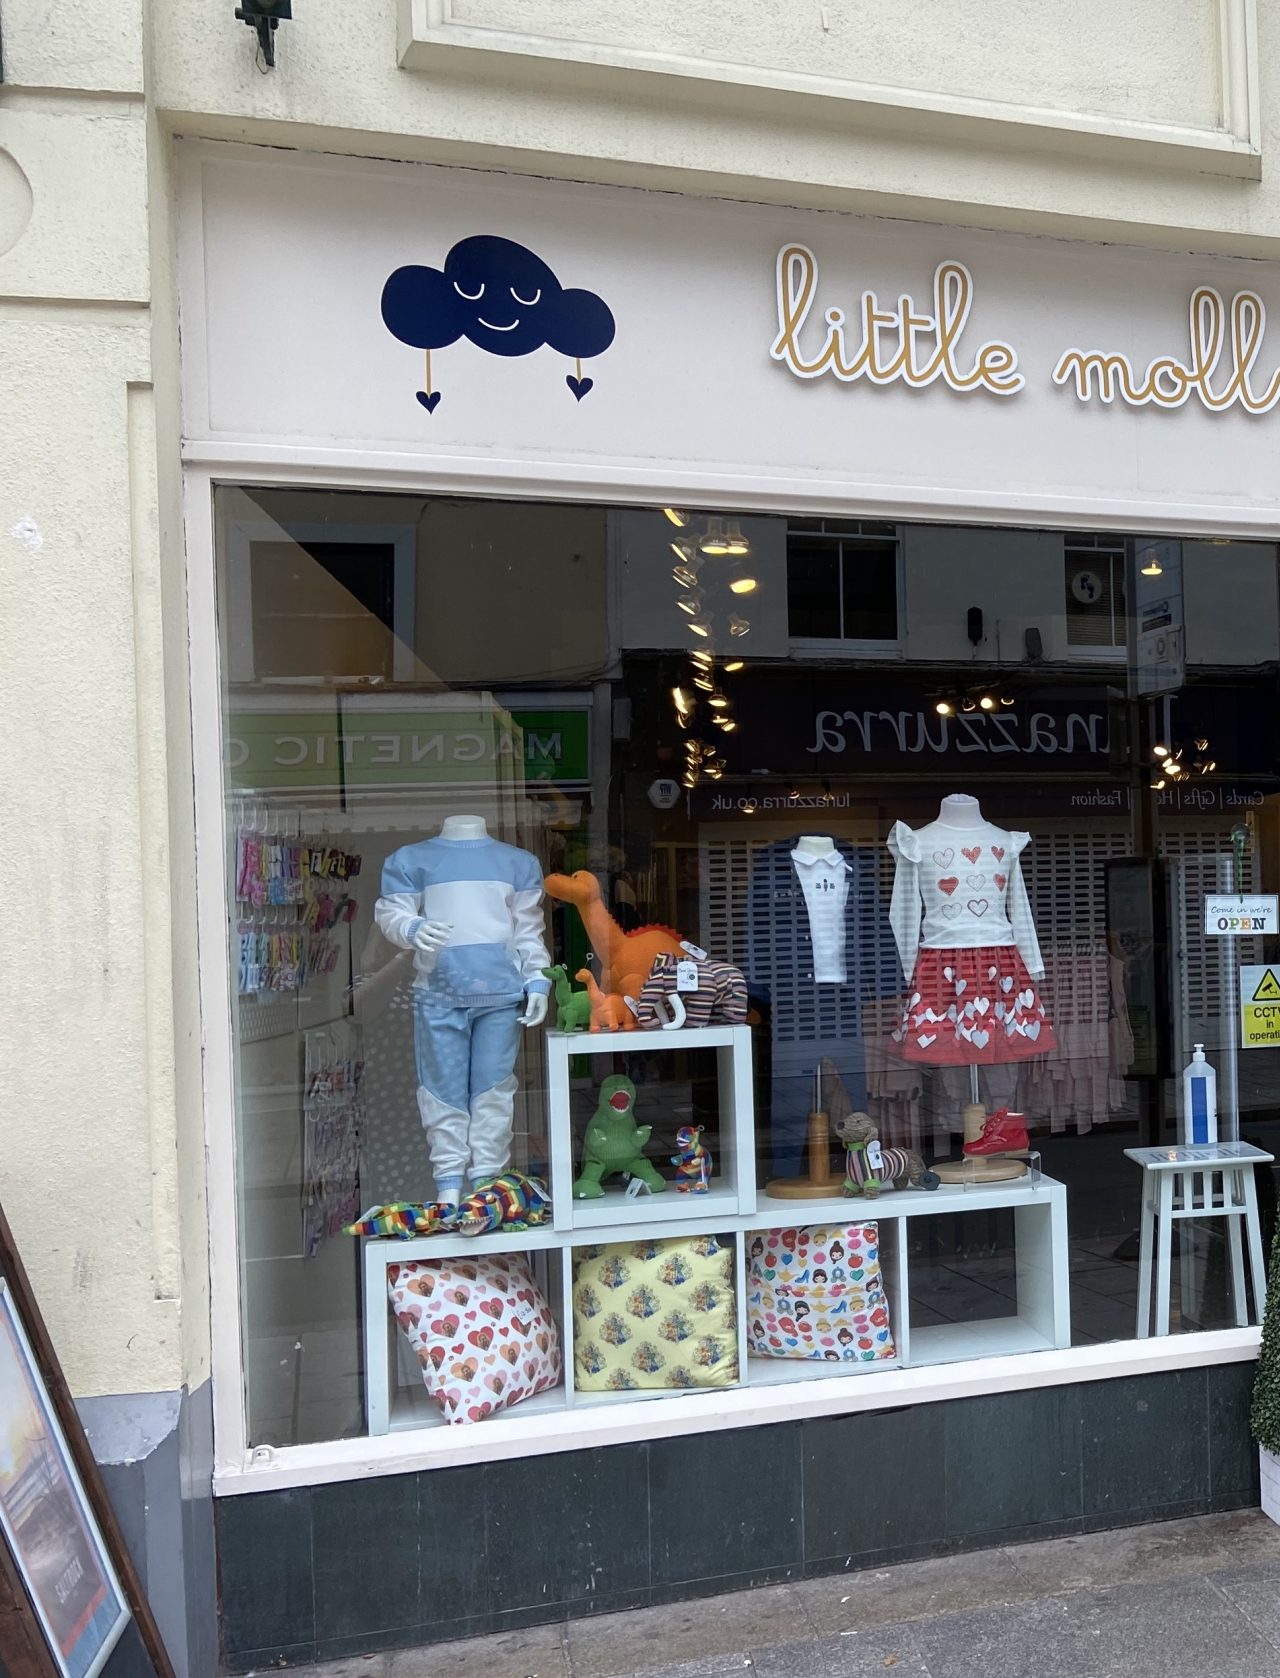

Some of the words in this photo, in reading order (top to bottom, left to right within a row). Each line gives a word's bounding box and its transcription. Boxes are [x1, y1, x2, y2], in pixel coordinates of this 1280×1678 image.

[770, 242, 1026, 396] little
[1210, 905, 1233, 914] Come
[1236, 905, 1248, 914] in
[1250, 905, 1273, 914] we're
[1217, 917, 1266, 931] OPEN
[1266, 1019, 1274, 1029] in
